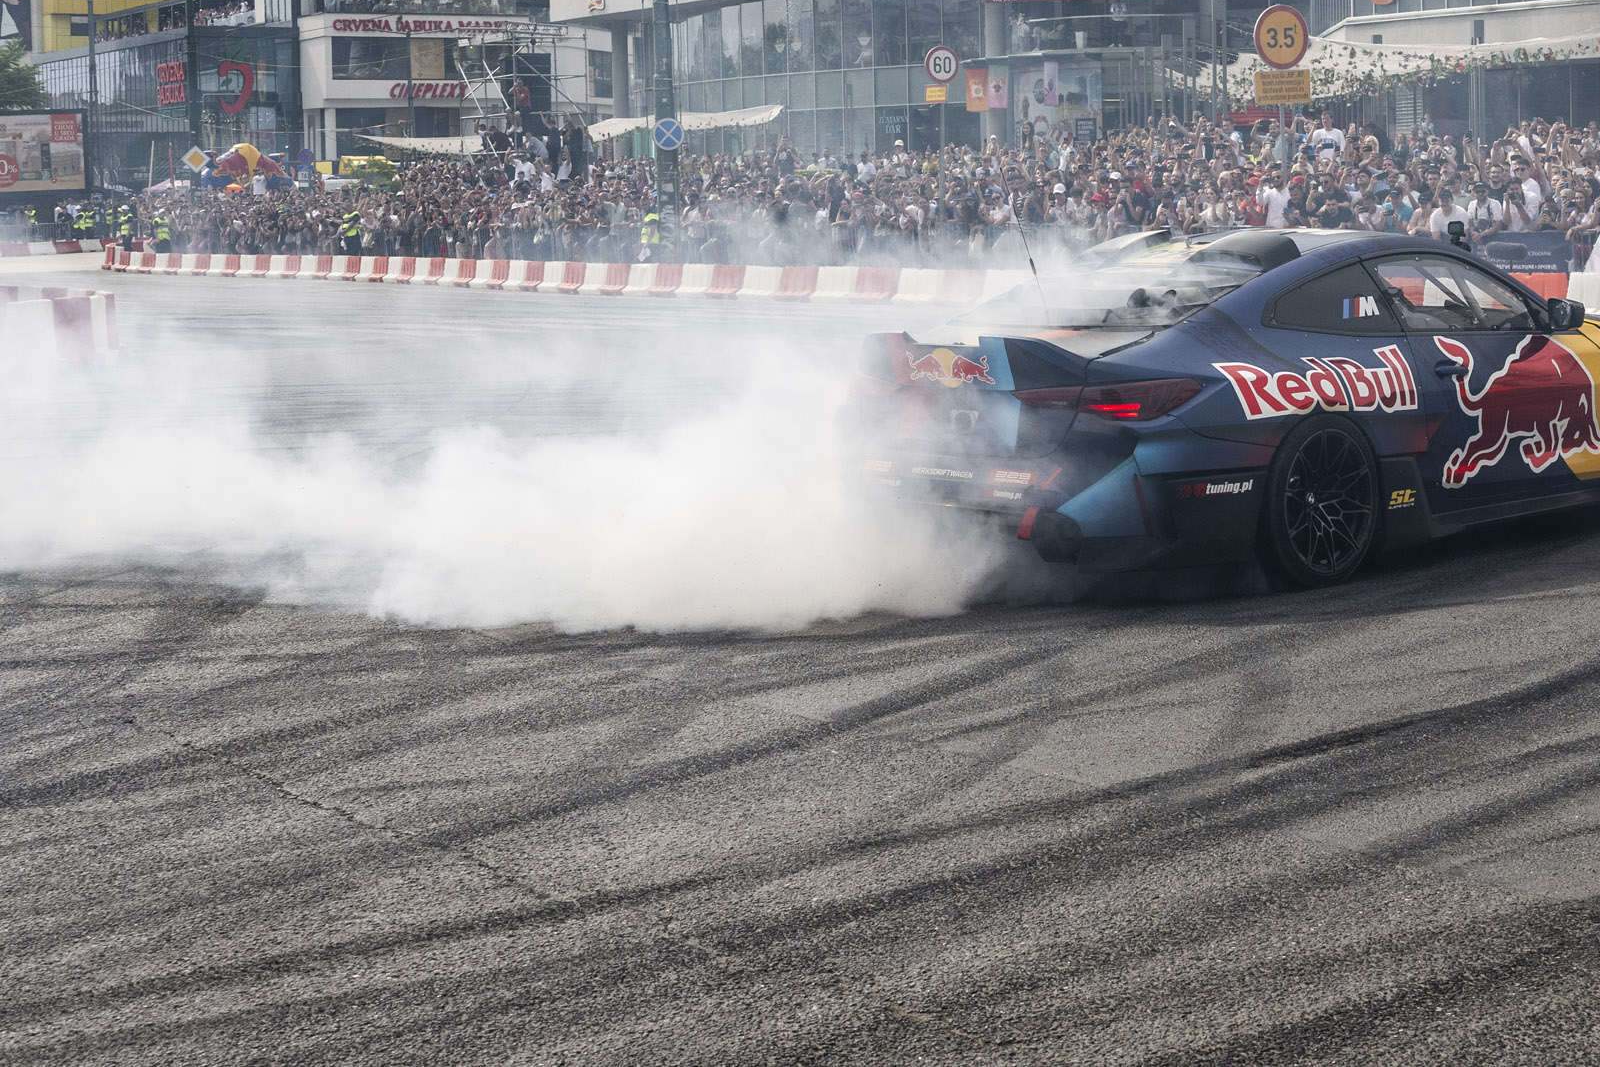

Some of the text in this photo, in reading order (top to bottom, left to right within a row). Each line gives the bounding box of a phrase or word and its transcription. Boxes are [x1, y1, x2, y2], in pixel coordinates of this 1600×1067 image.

[333, 19, 392, 32] CRVENA
[1266, 27, 1295, 49] 3.5
[933, 56, 952, 74] 60
[1213, 344, 1418, 420] Red Bull
[911, 467, 974, 479] WERKSDRIFTWAGEN
[993, 489, 1022, 500] tuning.pl
[1205, 479, 1254, 496] tuning.pl
